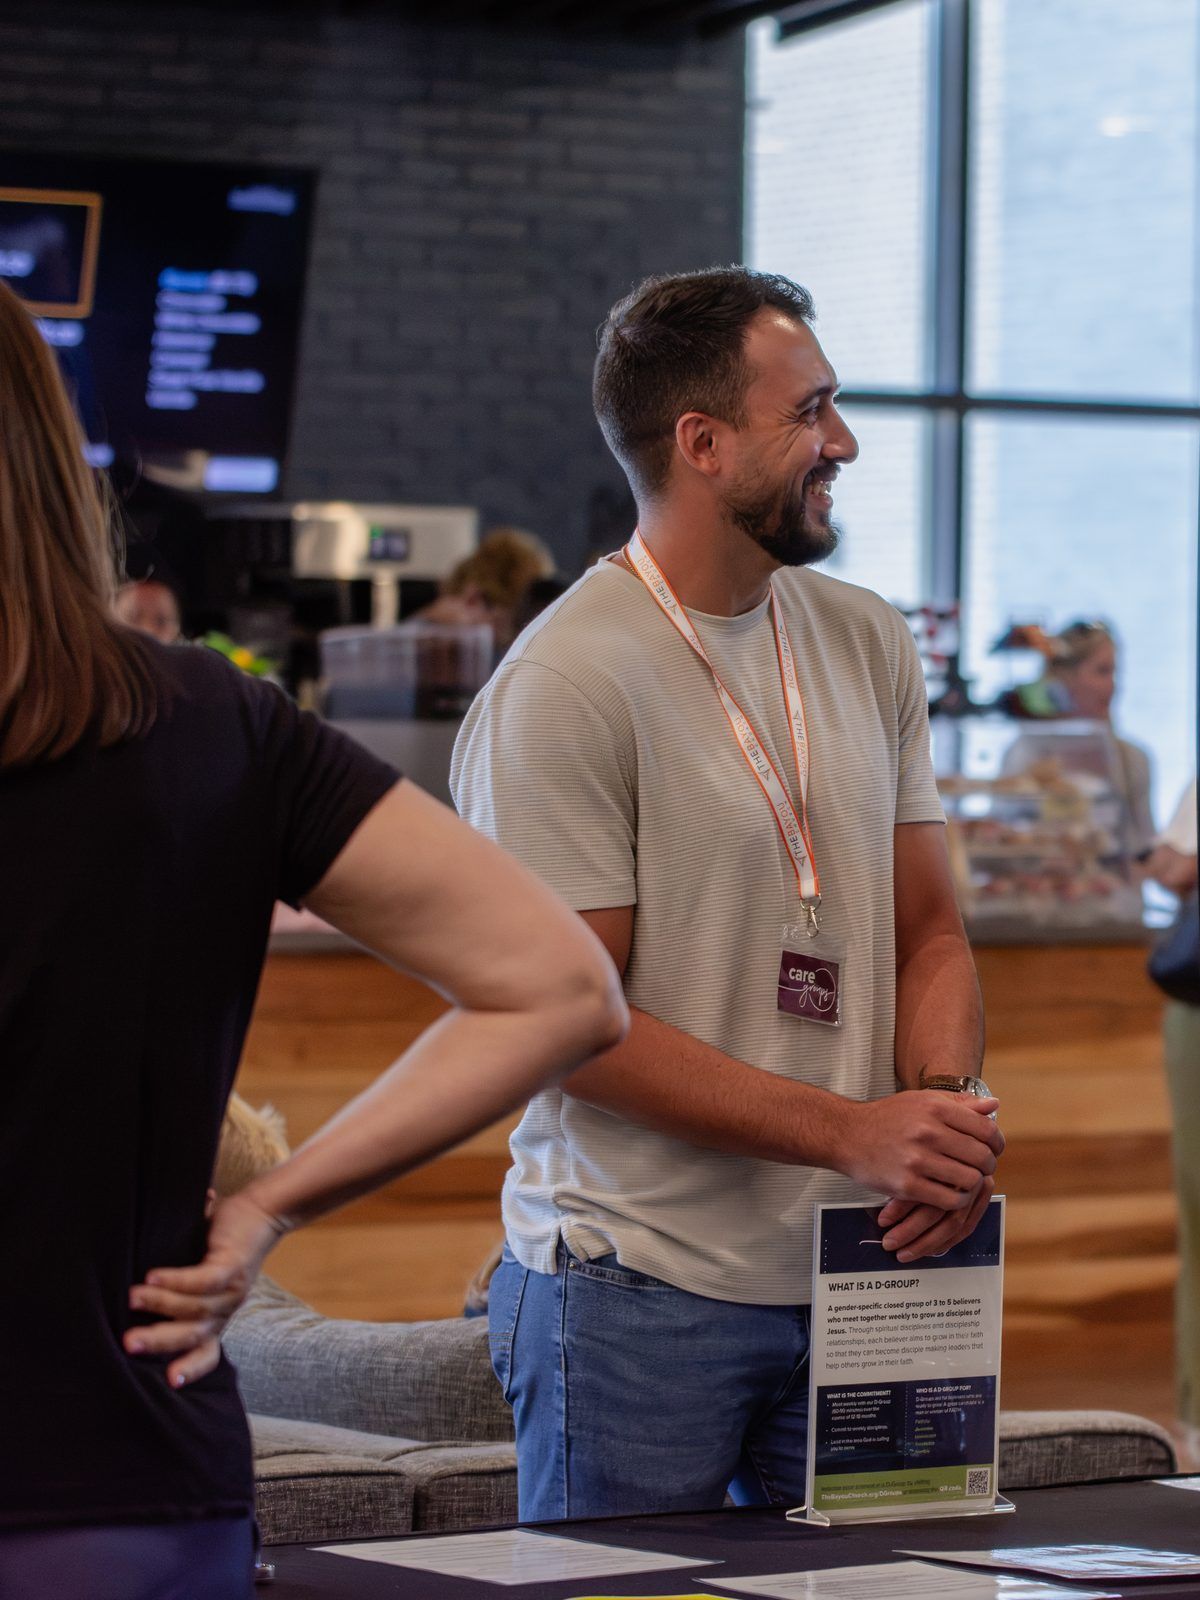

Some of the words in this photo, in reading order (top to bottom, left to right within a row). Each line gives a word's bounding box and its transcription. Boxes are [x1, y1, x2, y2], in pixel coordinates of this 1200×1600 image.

[788, 967, 816, 984] care
[828, 1282, 854, 1292] WHAT
[856, 1282, 865, 1290] IS
[866, 1281, 873, 1290] A
[875, 1279, 920, 1290] D-GROUP?
[834, 1302, 882, 1313] gender-specific
[883, 1301, 904, 1309] closed
[906, 1301, 924, 1309] group
[860, 1314, 887, 1323] together
[946, 1309, 972, 1317] disciples
[849, 1326, 874, 1334] Through
[900, 1323, 931, 1331] disciplines
[945, 1320, 980, 1329] discipleship
[827, 1338, 866, 1346] relationships,
[932, 1334, 947, 1342] grow
[848, 1350, 861, 1358] they
[901, 1346, 924, 1354] disciple
[925, 1344, 947, 1352] making
[826, 1362, 839, 1370] help
[861, 1361, 877, 1369] grow
